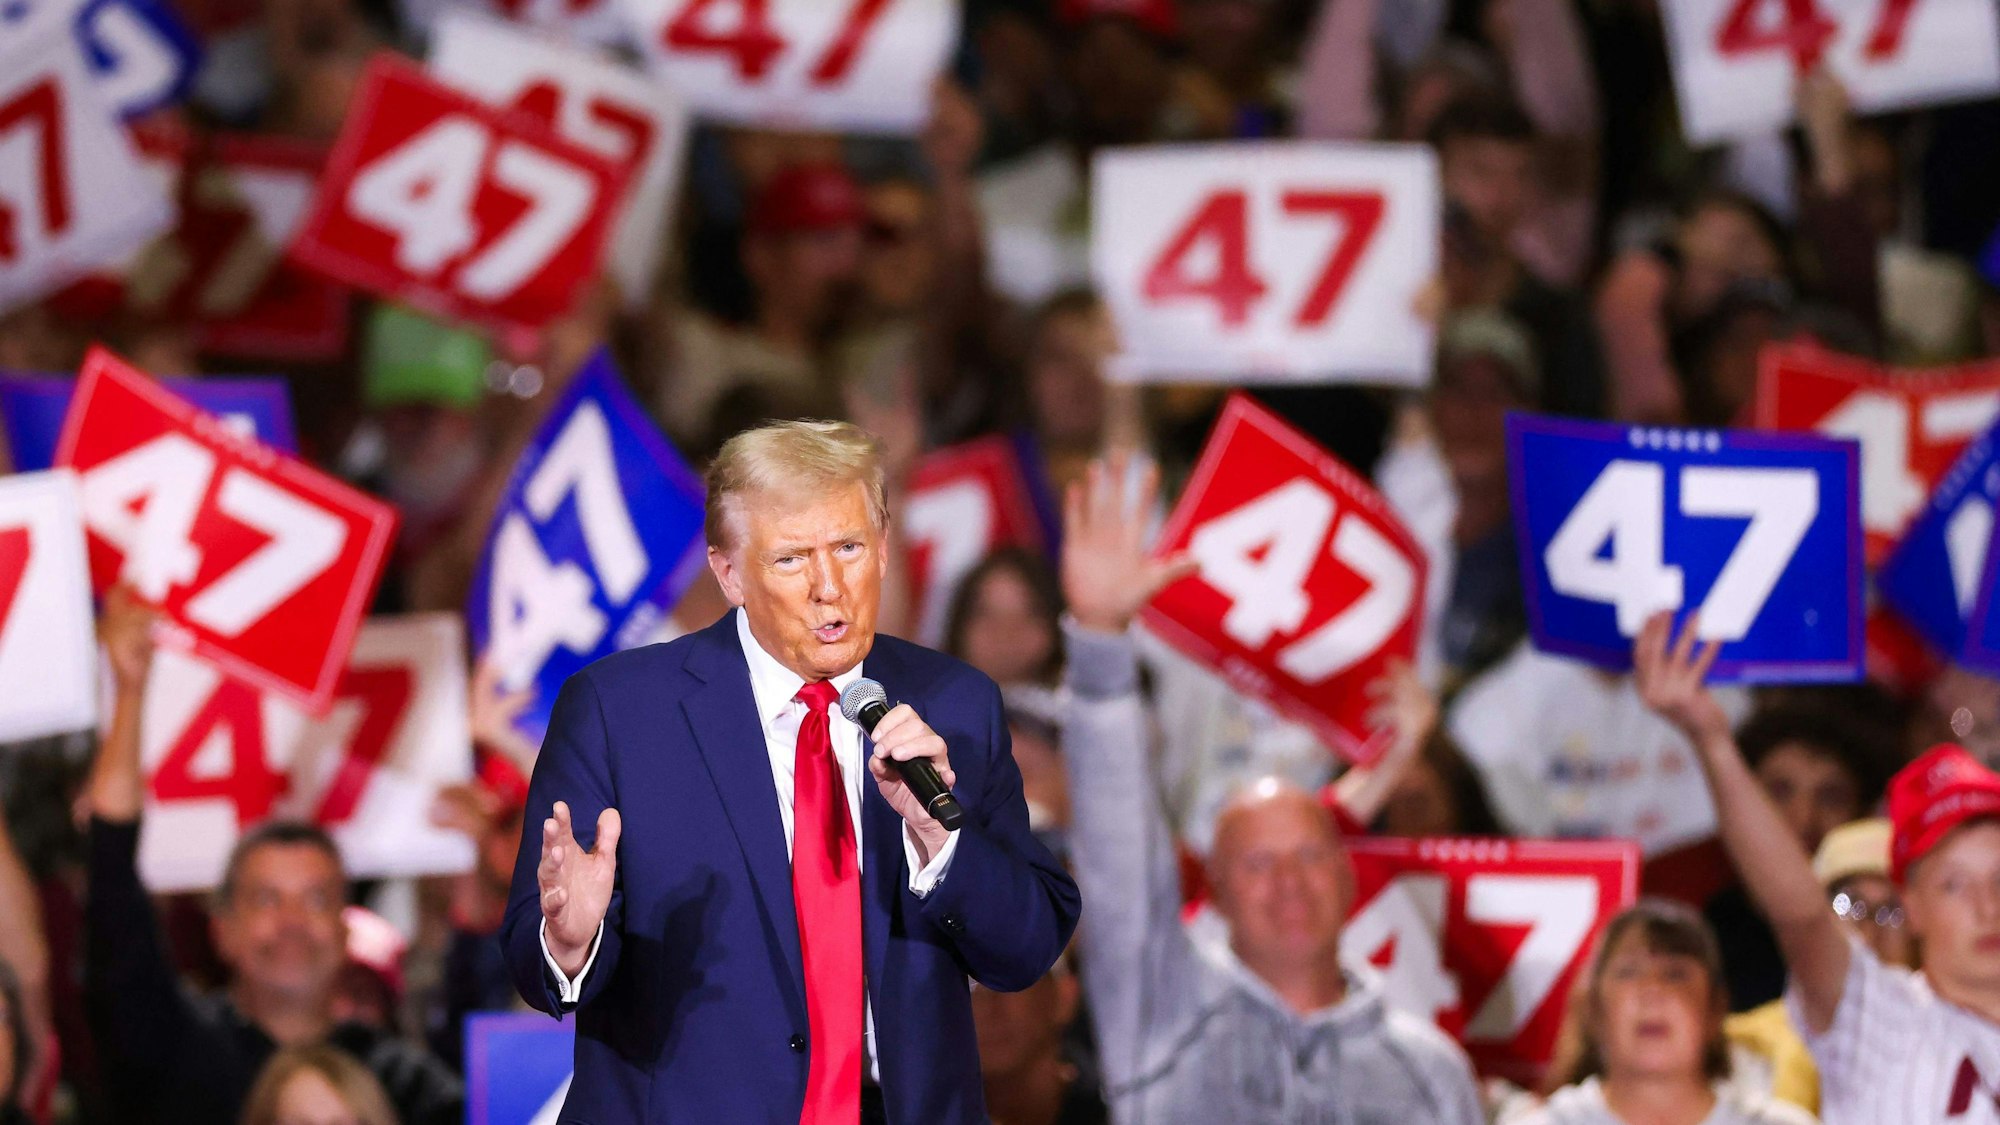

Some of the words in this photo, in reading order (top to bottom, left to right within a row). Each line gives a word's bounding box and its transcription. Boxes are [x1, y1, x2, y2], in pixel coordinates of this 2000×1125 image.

[346, 117, 599, 298] 47
[1142, 188, 1388, 328] 47
[80, 430, 350, 638] 47
[486, 400, 650, 694] 47
[1190, 478, 1417, 684] 47
[1544, 459, 1819, 642] 47
[146, 664, 414, 836] 47
[1337, 873, 1599, 1041] 47
